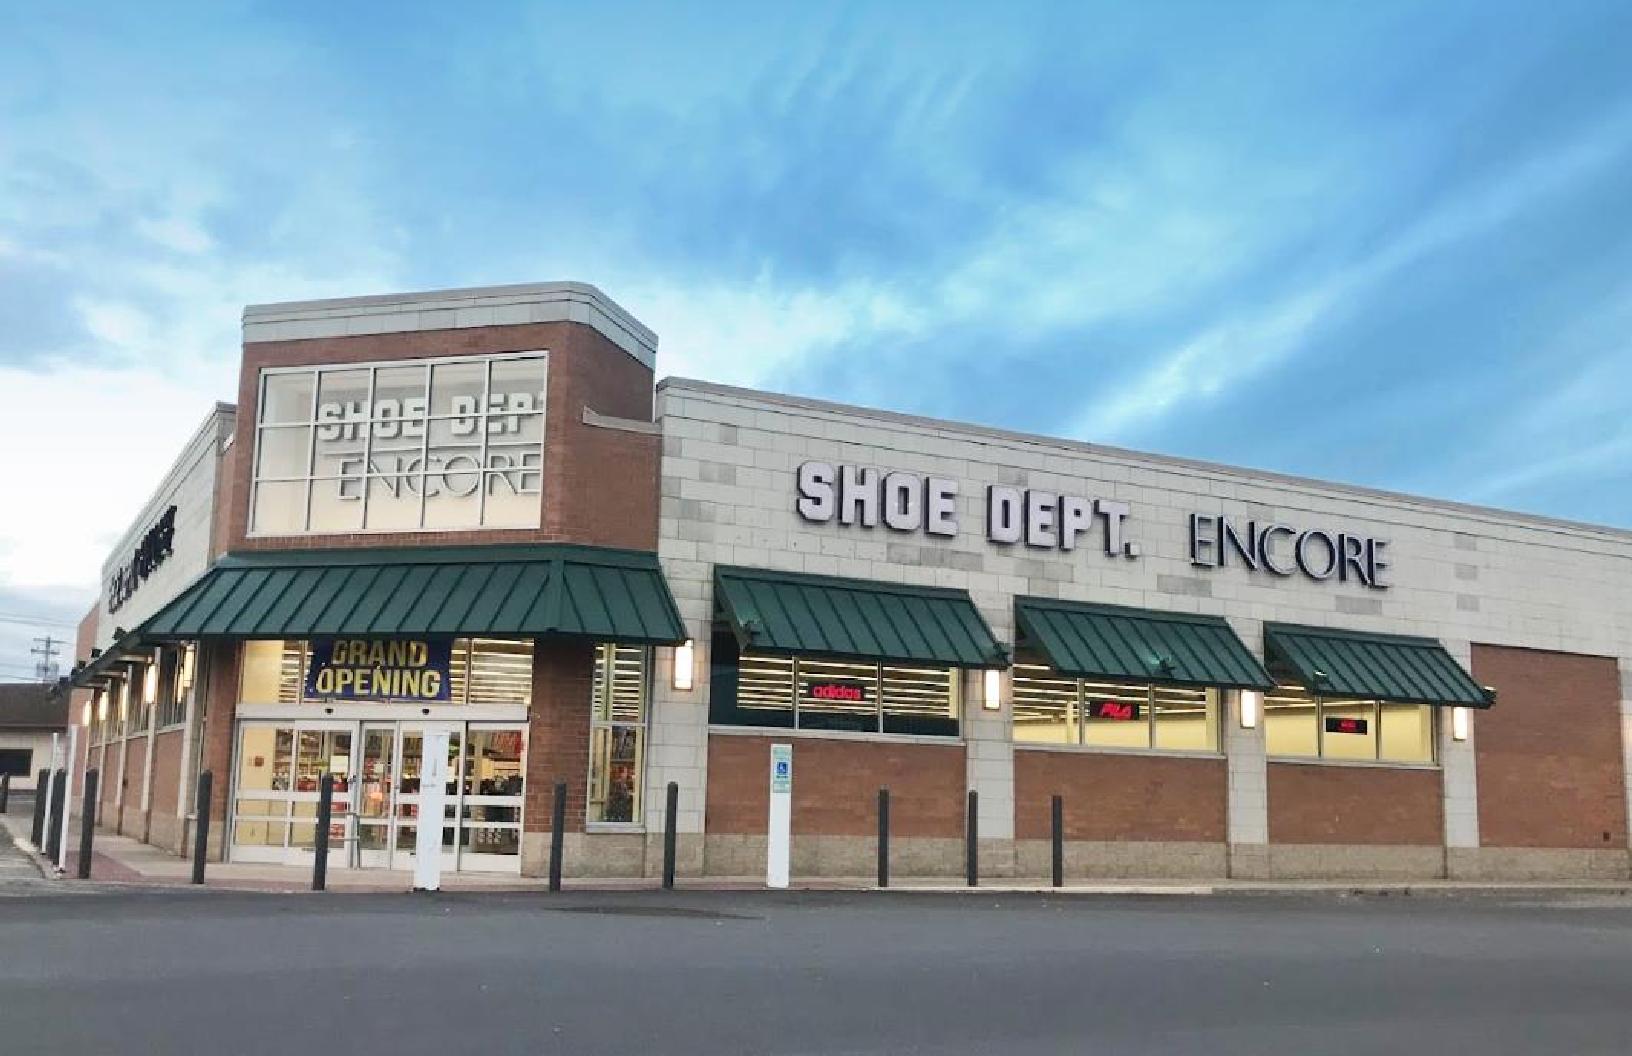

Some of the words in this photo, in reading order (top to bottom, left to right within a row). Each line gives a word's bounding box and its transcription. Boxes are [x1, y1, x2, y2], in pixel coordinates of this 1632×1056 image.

[318, 398, 426, 441] SHOE
[451, 391, 544, 437] DEP
[337, 451, 541, 500] ENCORE
[797, 460, 958, 537] SHOE
[987, 484, 1140, 558] DEPT.
[1190, 513, 1391, 589] ENCORE
[332, 640, 429, 666] GRAND
[316, 668, 441, 698] OPENING
[813, 685, 861, 699] adidas
